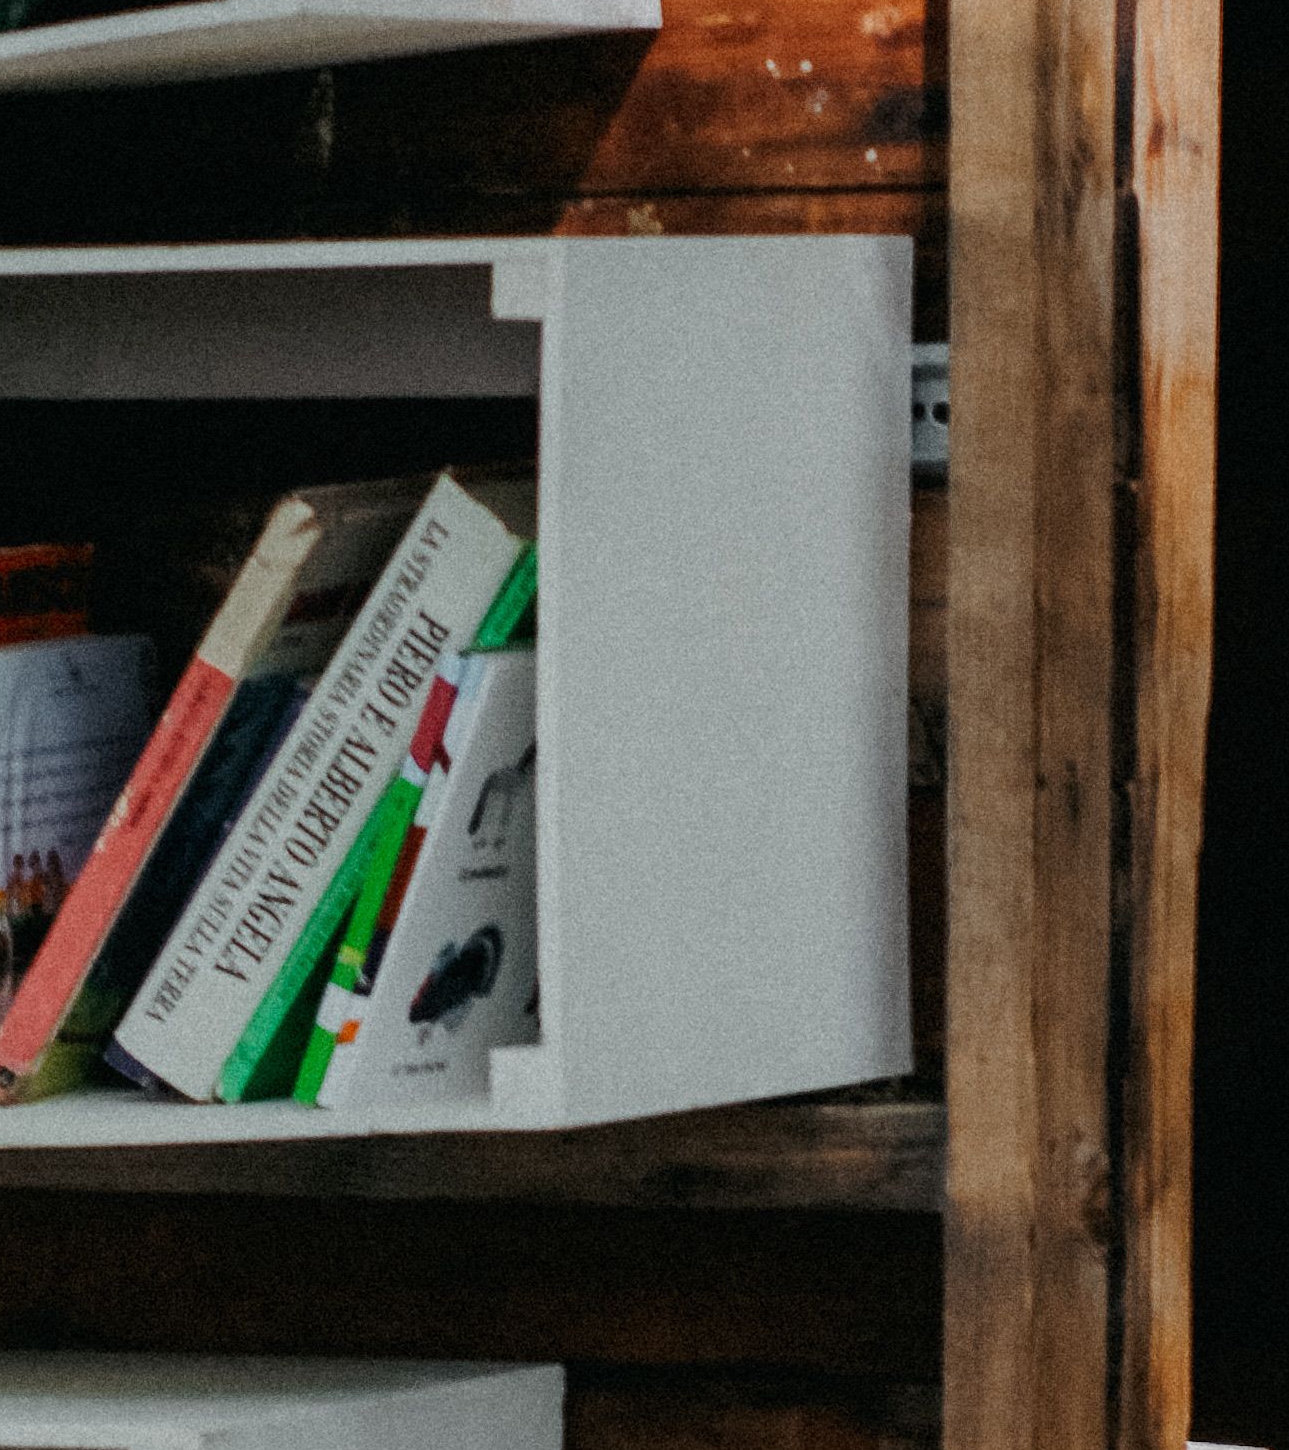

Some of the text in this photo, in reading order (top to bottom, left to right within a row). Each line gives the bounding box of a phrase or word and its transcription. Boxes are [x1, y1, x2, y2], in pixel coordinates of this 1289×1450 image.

[140, 516, 451, 1027] LA STRAORDINARIA STORIA DELLA VITA SULLA TERRA
[209, 606, 455, 989] PIERO E ALBERTO ANGELA
